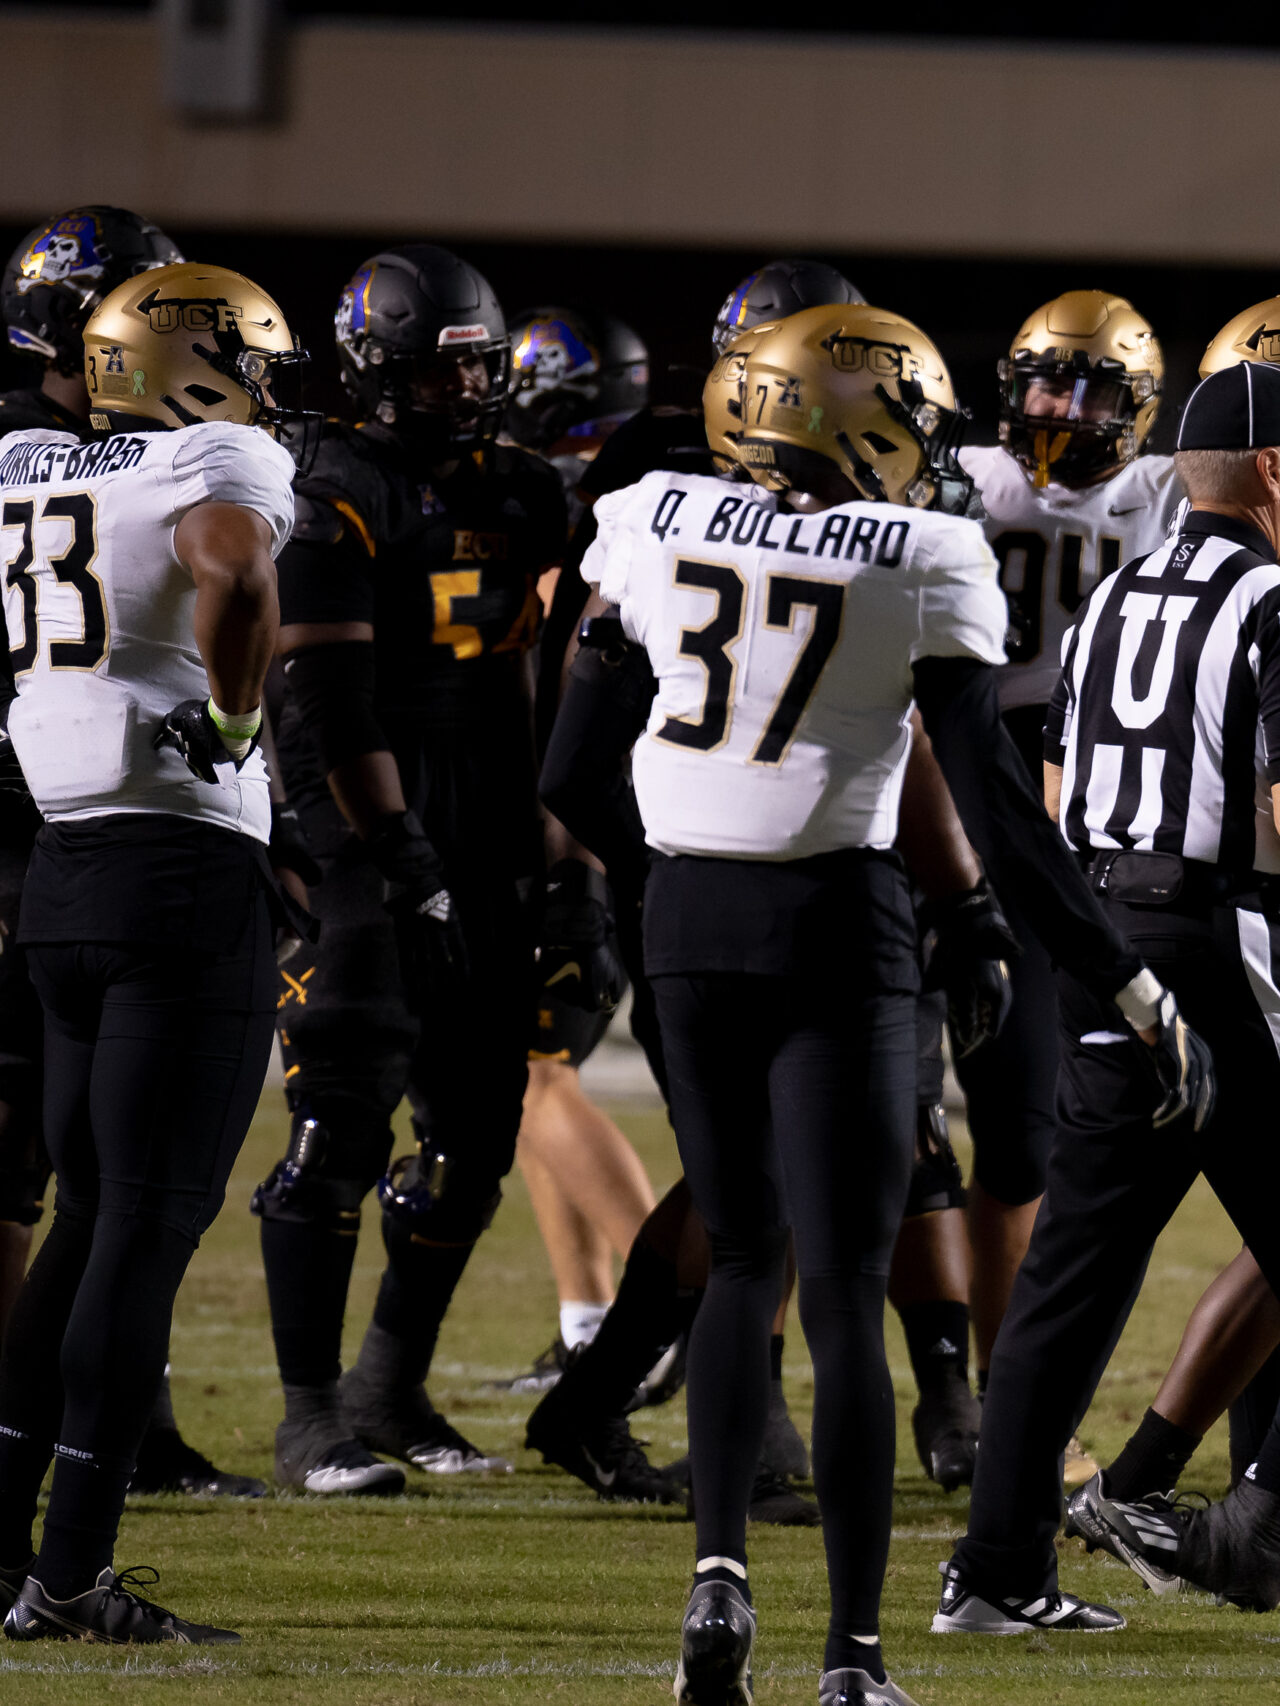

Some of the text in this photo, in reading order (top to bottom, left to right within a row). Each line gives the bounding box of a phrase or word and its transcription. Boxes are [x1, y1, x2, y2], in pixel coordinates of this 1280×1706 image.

[149, 303, 243, 334] UCF
[832, 341, 925, 383] UCF
[0, 489, 111, 678] 33
[704, 496, 911, 568] BULLARD
[651, 553, 848, 768] 37
[1111, 591, 1199, 729] U
